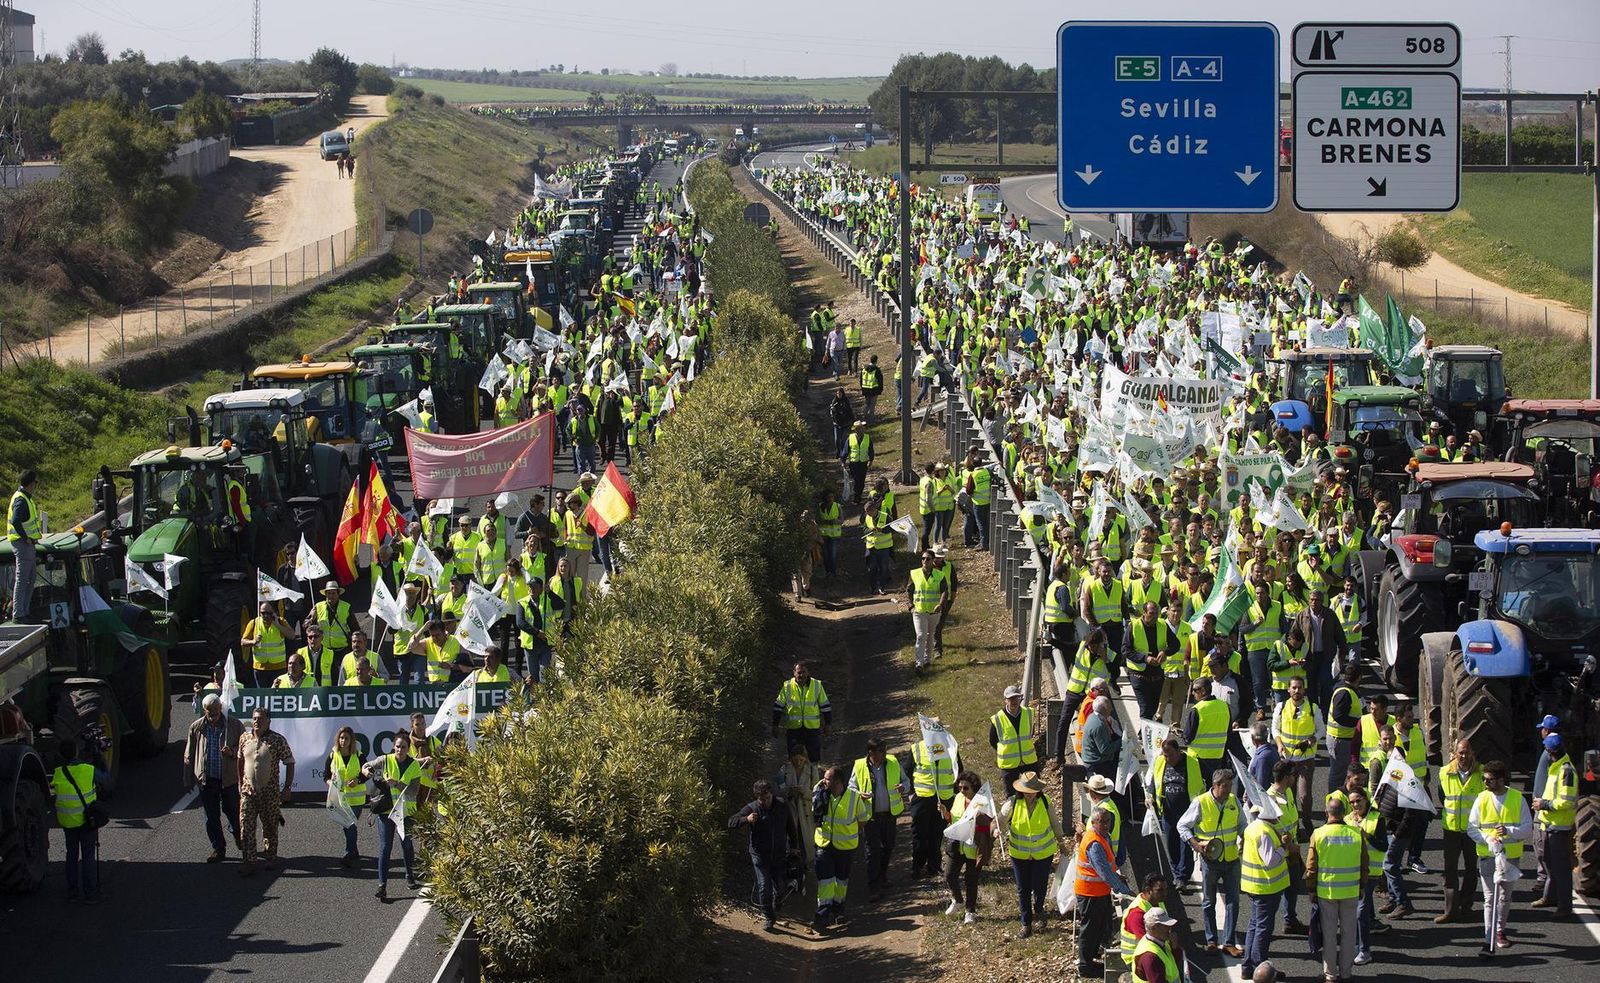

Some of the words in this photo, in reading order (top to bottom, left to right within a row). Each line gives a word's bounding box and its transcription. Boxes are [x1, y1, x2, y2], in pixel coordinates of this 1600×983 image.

[1405, 38, 1445, 54] 508
[1119, 60, 1156, 77] E-5
[1176, 60, 1218, 77] A-4
[1120, 98, 1217, 118] Sevilla
[1345, 90, 1408, 107] A-462
[1307, 117, 1446, 138] CARMONA
[1128, 134, 1209, 155] Cádiz
[1321, 144, 1432, 164] BRENES
[1120, 379, 1220, 405] GUADALCANAL
[368, 439, 388, 450] 3200
[242, 694, 322, 713] PUEBLA
[328, 693, 357, 710] DE
[363, 692, 406, 710] LOS
[413, 689, 512, 709] INFTES
